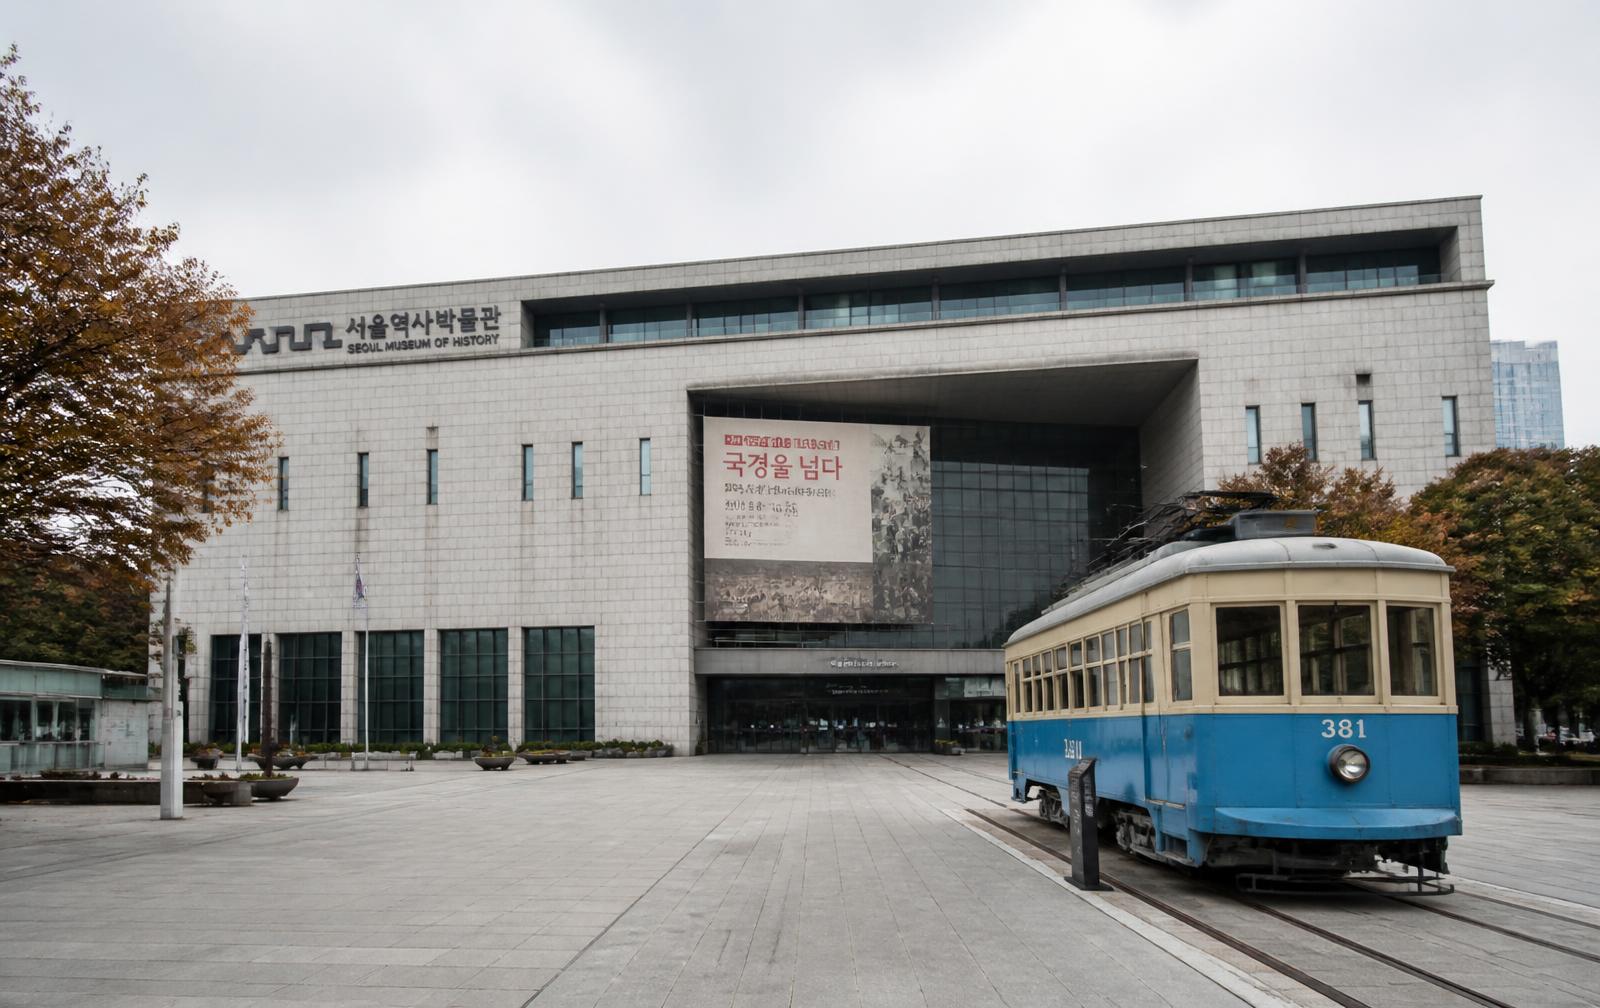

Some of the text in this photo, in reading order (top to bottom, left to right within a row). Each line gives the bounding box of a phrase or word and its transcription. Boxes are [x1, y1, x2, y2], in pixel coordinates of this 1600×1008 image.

[347, 334, 500, 354] SEOUL MUSEUM OF HISTORY
[800, 455, 843, 480] 넘다
[1321, 719, 1367, 738] 381
